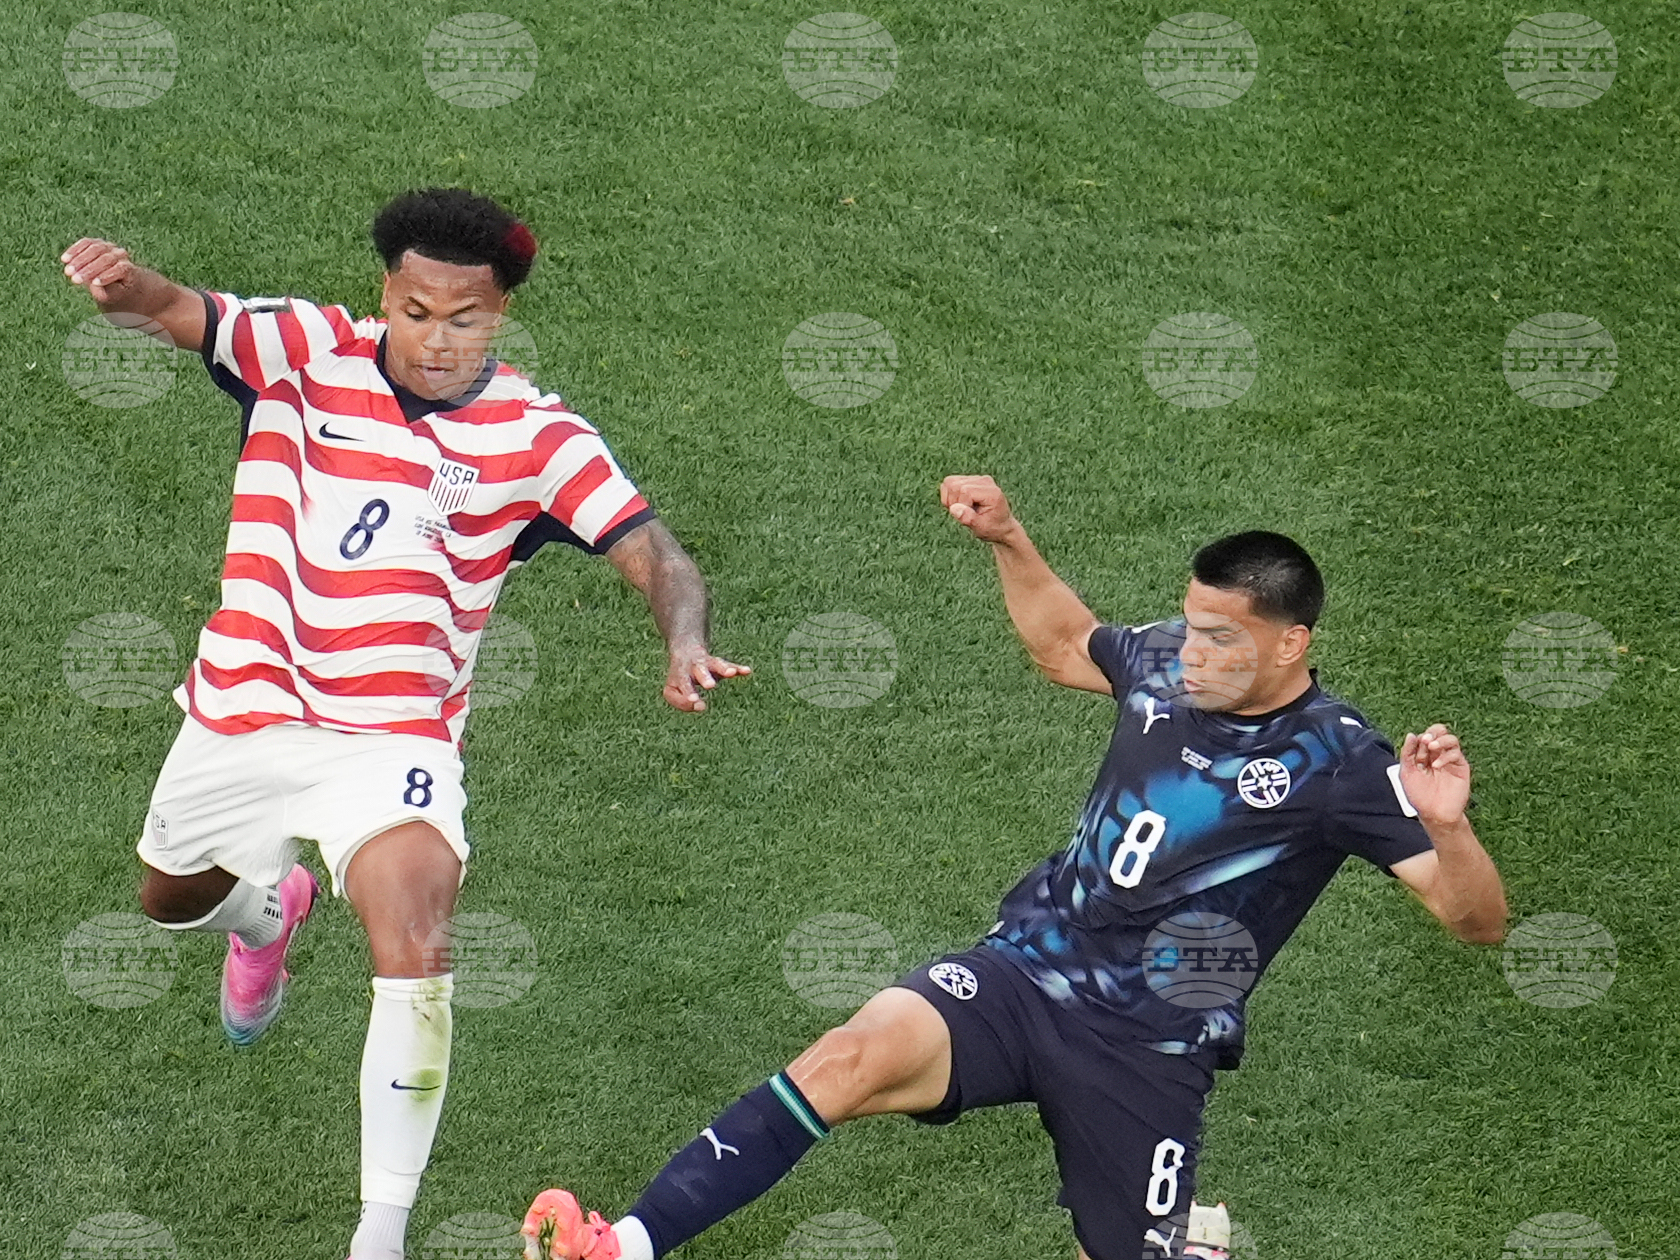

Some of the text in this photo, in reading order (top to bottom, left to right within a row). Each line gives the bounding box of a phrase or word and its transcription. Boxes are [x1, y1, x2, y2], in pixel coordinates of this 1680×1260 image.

[440, 462, 475, 485] USA
[340, 499, 390, 560] 8
[404, 768, 433, 807] 8
[1109, 810, 1167, 889] 8
[1146, 1138, 1186, 1216] 8
